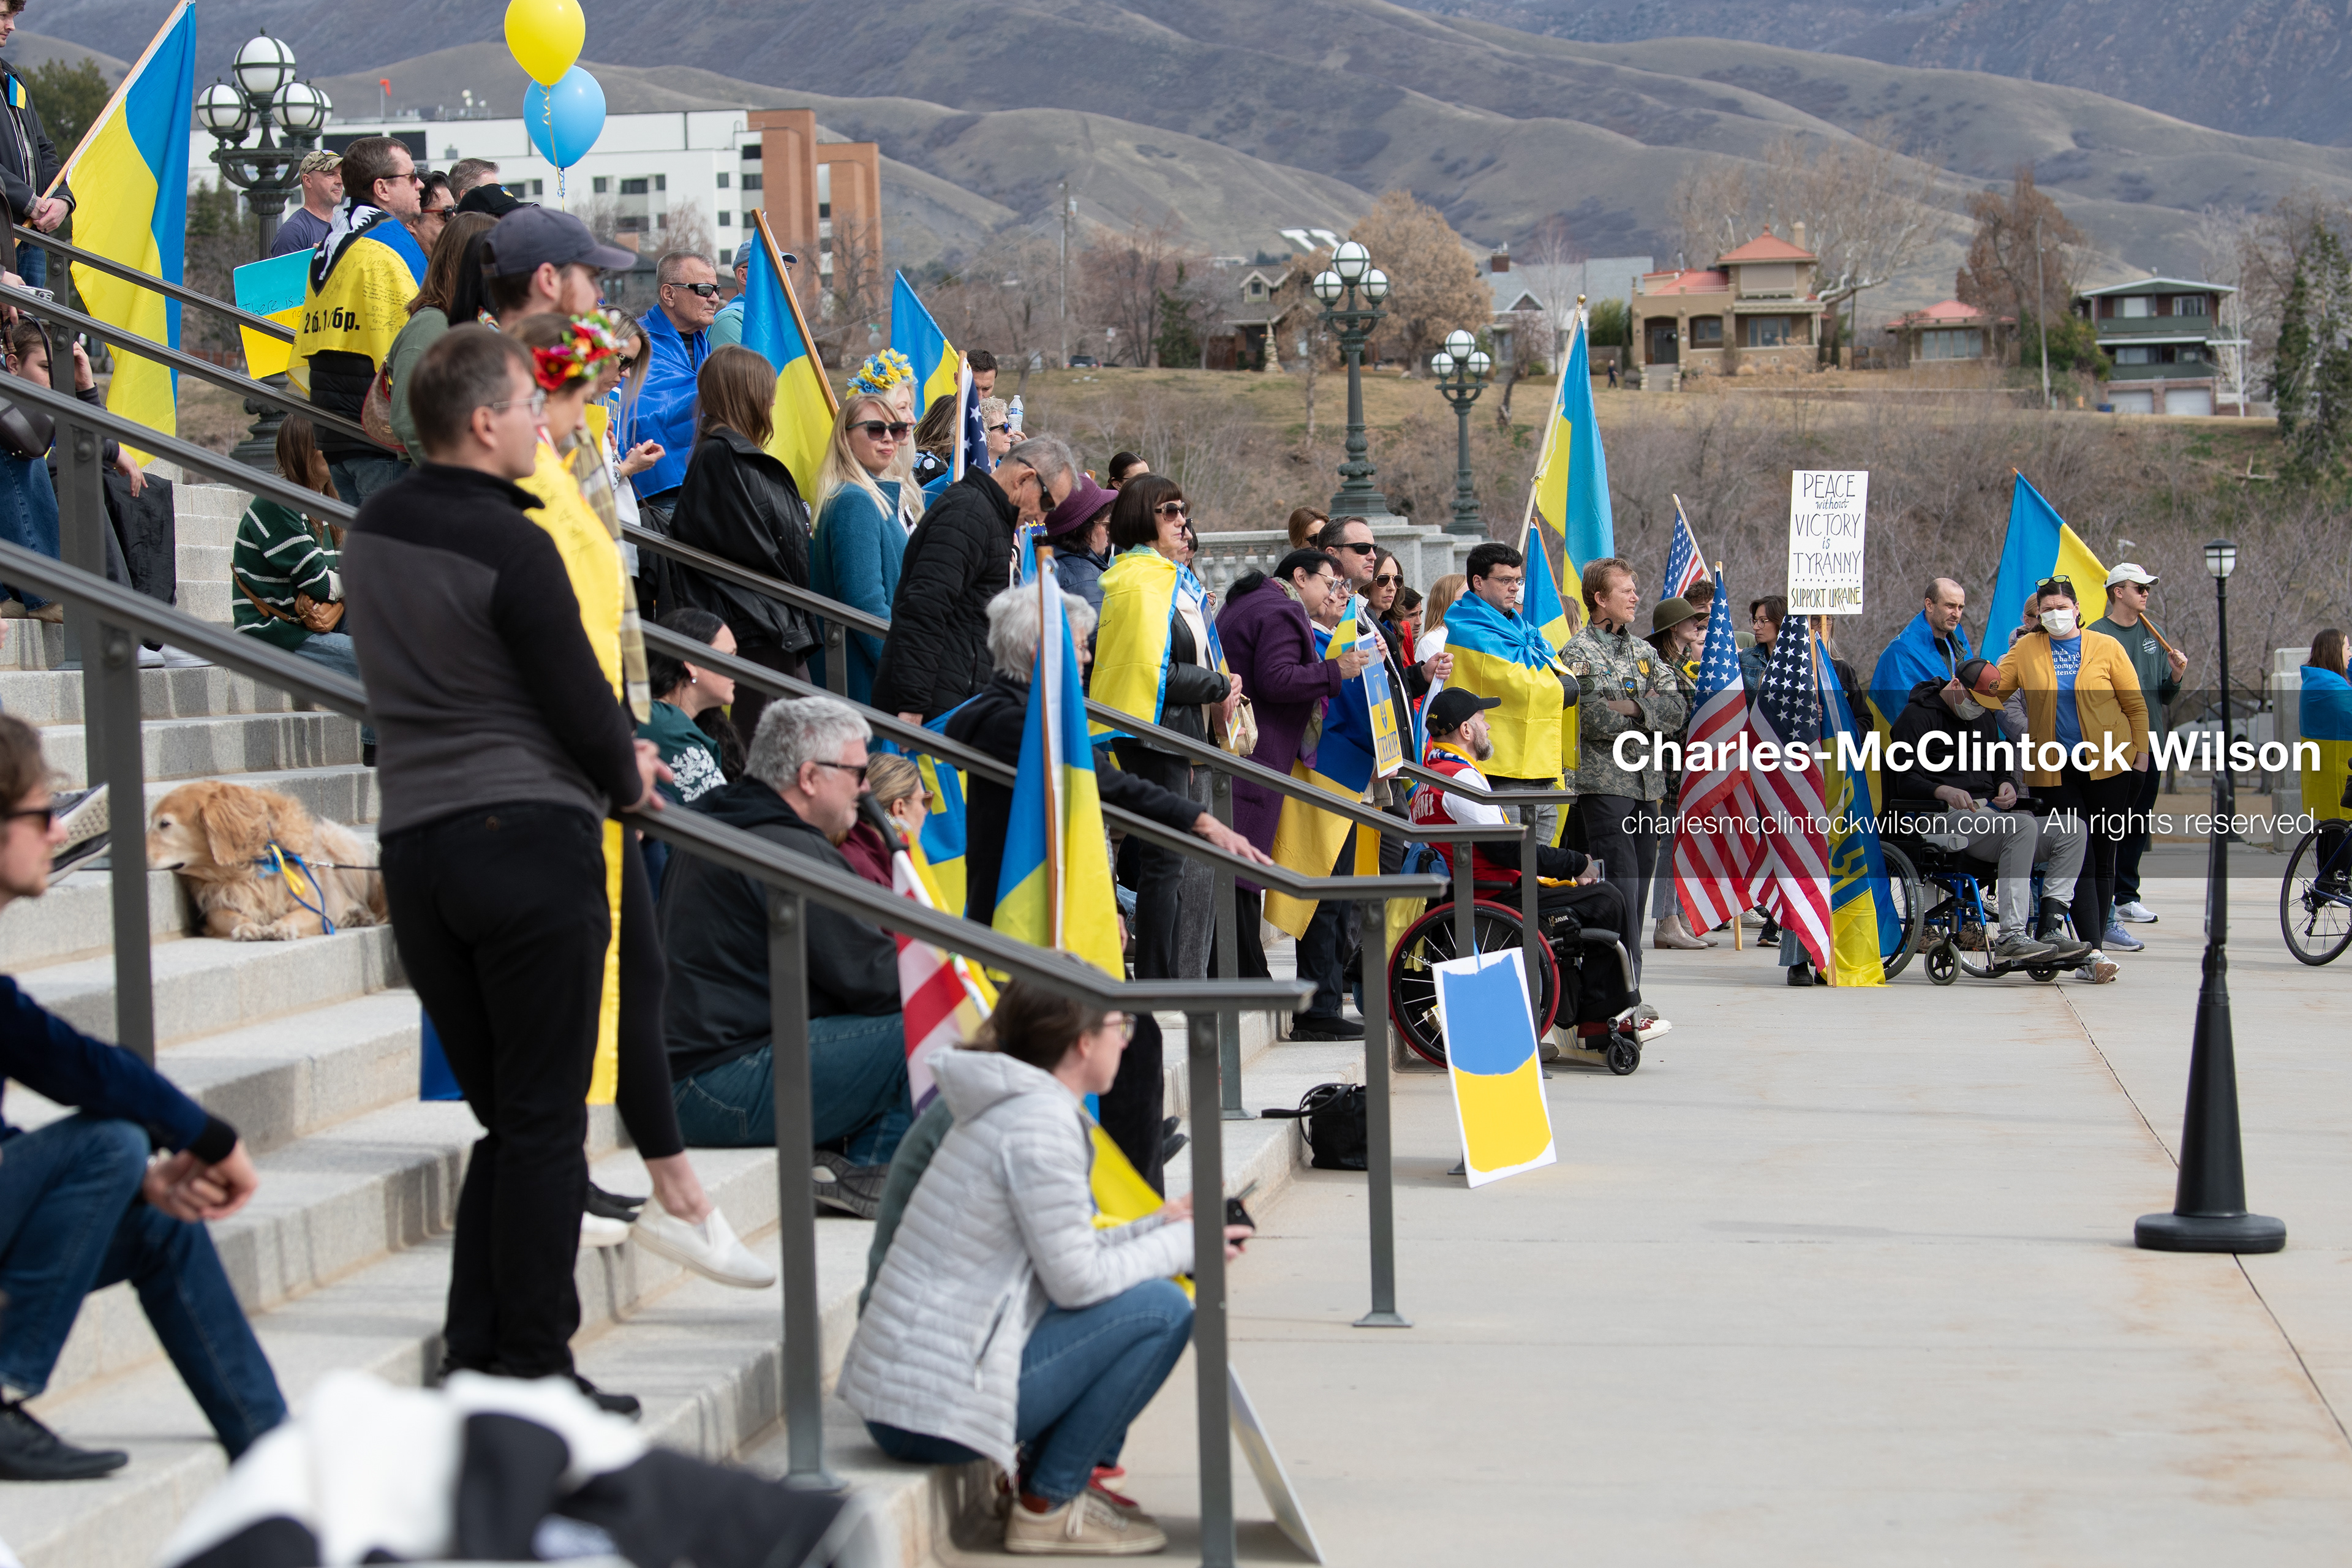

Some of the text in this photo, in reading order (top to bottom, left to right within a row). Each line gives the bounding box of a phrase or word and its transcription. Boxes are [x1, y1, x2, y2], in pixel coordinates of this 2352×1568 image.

[1803, 473, 1855, 498] PEACE
[1815, 497, 1849, 510] without
[1795, 513, 1861, 538] VICTORY
[1822, 537, 1831, 549] is
[1793, 551, 1861, 576] TYRANNY
[1791, 586, 1861, 612] SUPPORT UKRAINE
[1378, 731, 1400, 764] UKRAINE
